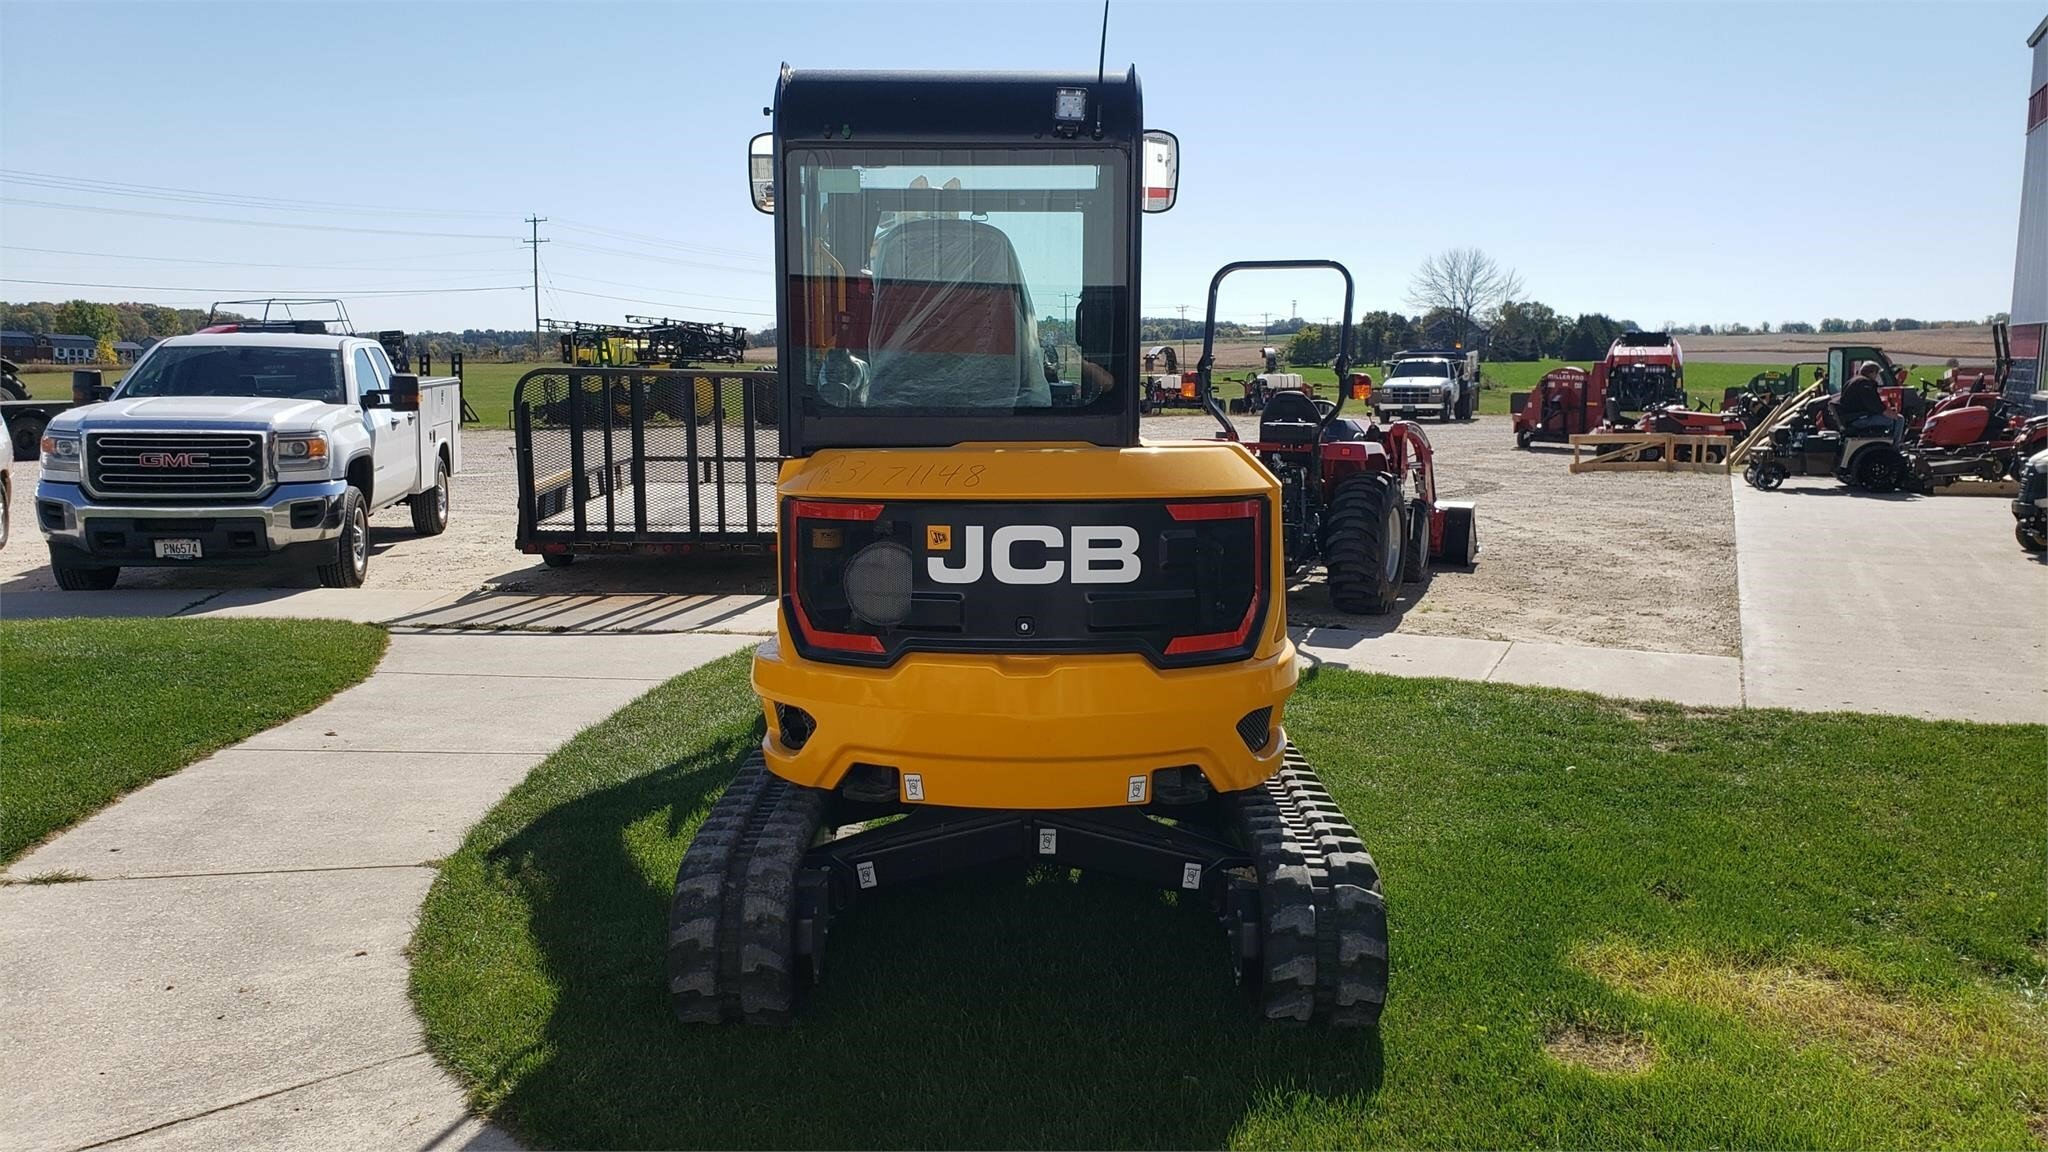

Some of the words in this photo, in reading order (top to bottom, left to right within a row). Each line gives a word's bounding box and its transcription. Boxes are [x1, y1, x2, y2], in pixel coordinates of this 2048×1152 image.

[140, 452, 210, 468] GMC
[163, 543, 198, 554] PN6574
[927, 525, 1142, 585] JCB
